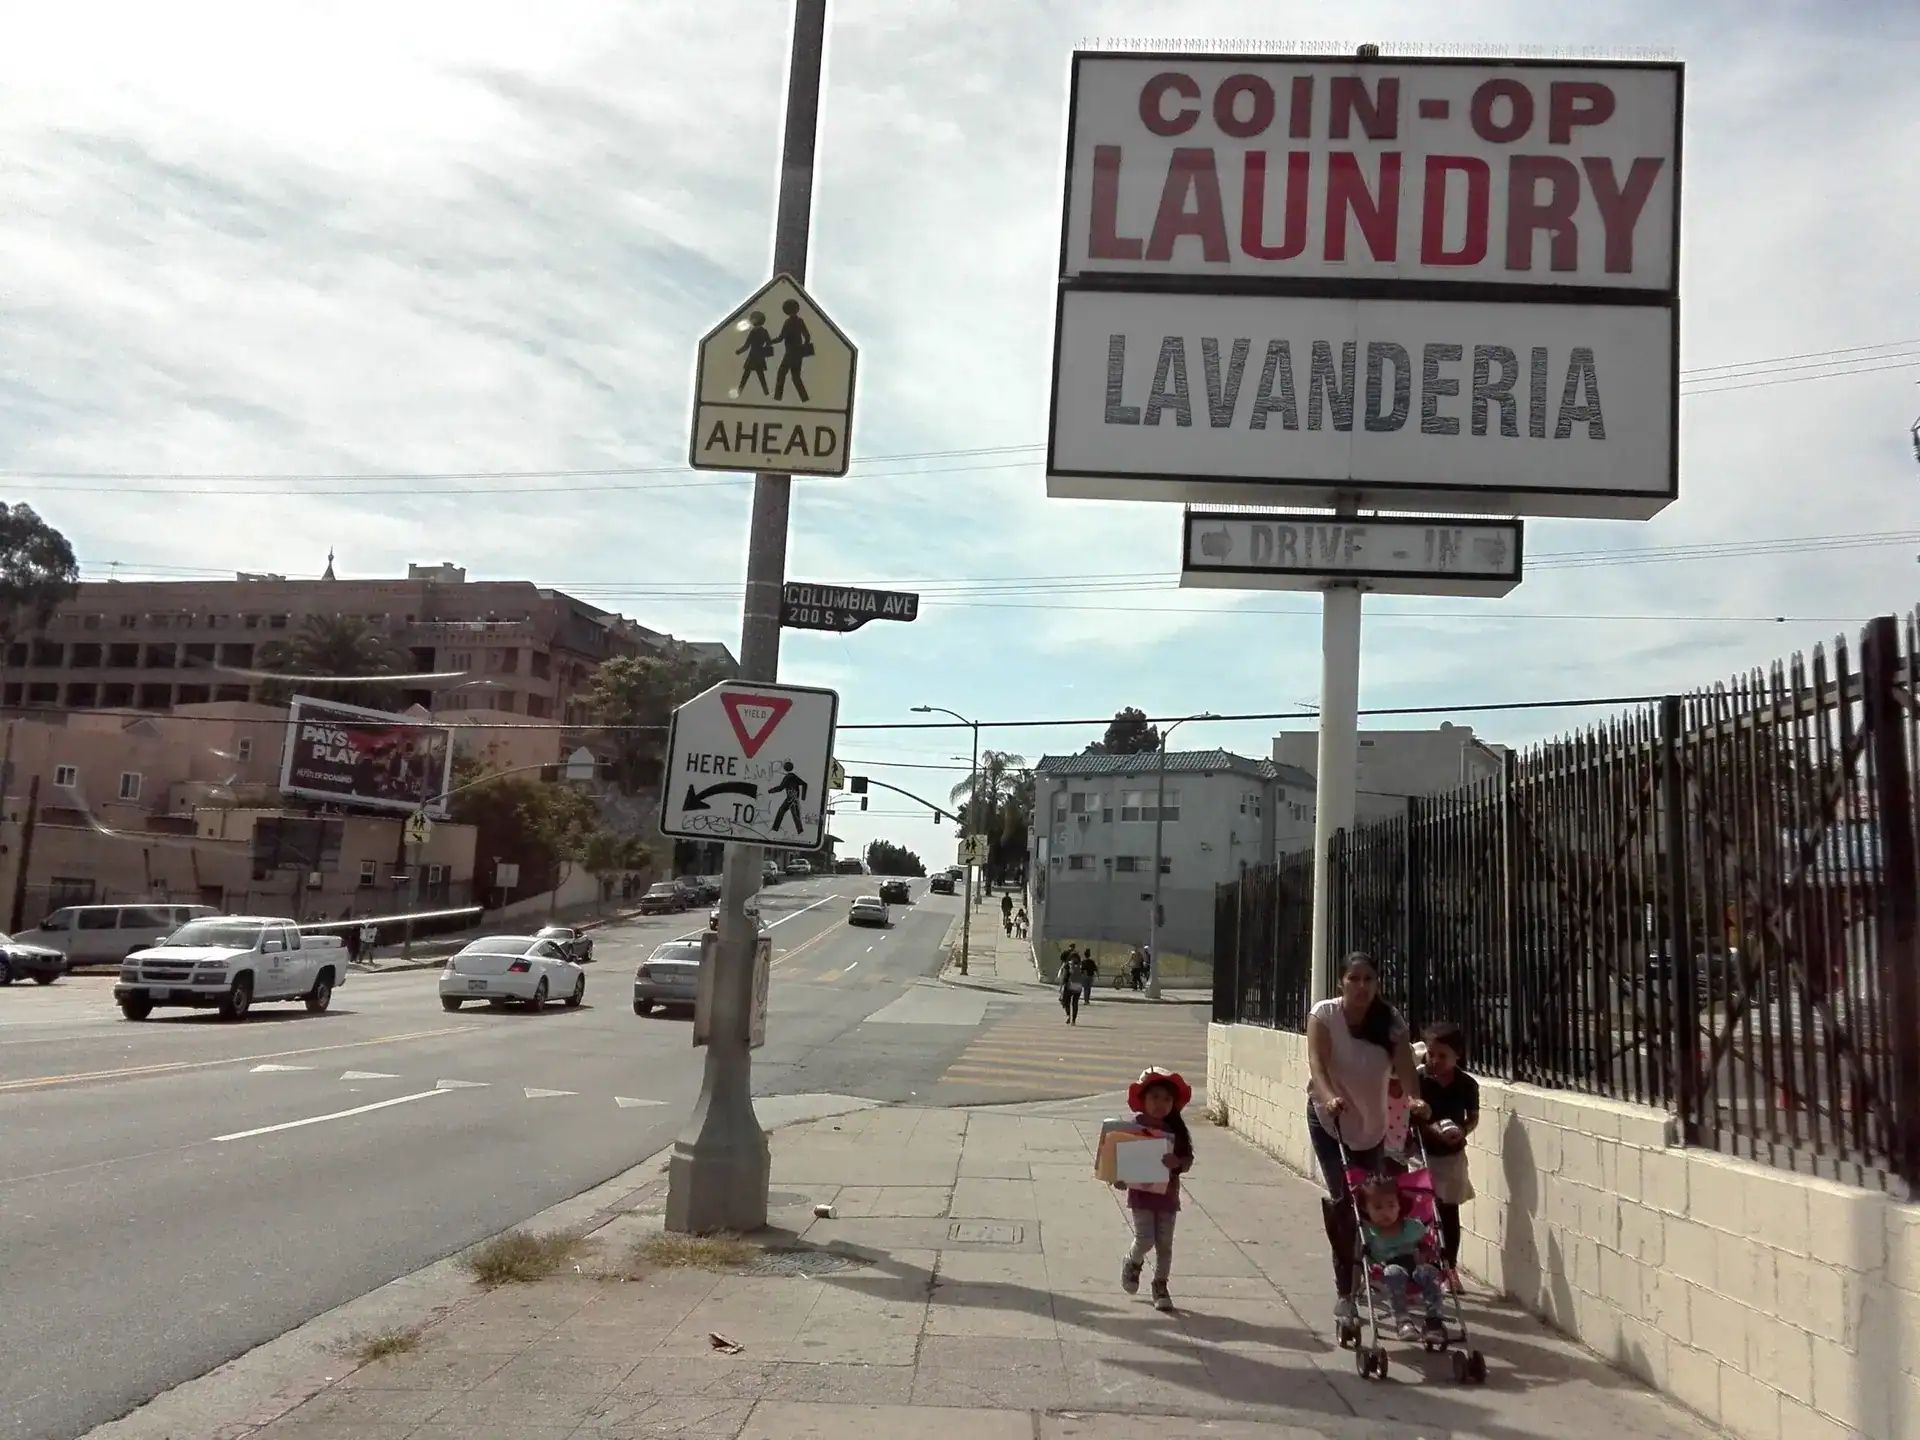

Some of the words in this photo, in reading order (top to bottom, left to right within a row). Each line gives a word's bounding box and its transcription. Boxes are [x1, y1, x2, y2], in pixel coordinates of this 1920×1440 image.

[1138, 72, 1616, 145] COIN-OP
[1088, 145, 1665, 274] LAUNDRY
[1103, 334, 1607, 440] LAVANDERIA
[705, 420, 837, 457] AHEAD
[787, 586, 877, 612] COLUMBIA
[882, 595, 916, 615] AVE
[789, 607, 820, 623] 200
[743, 708, 767, 719] YIELD
[301, 725, 349, 747] PAYS
[312, 744, 361, 765] PLAY
[686, 753, 739, 776] HERE
[732, 803, 755, 824] TO
